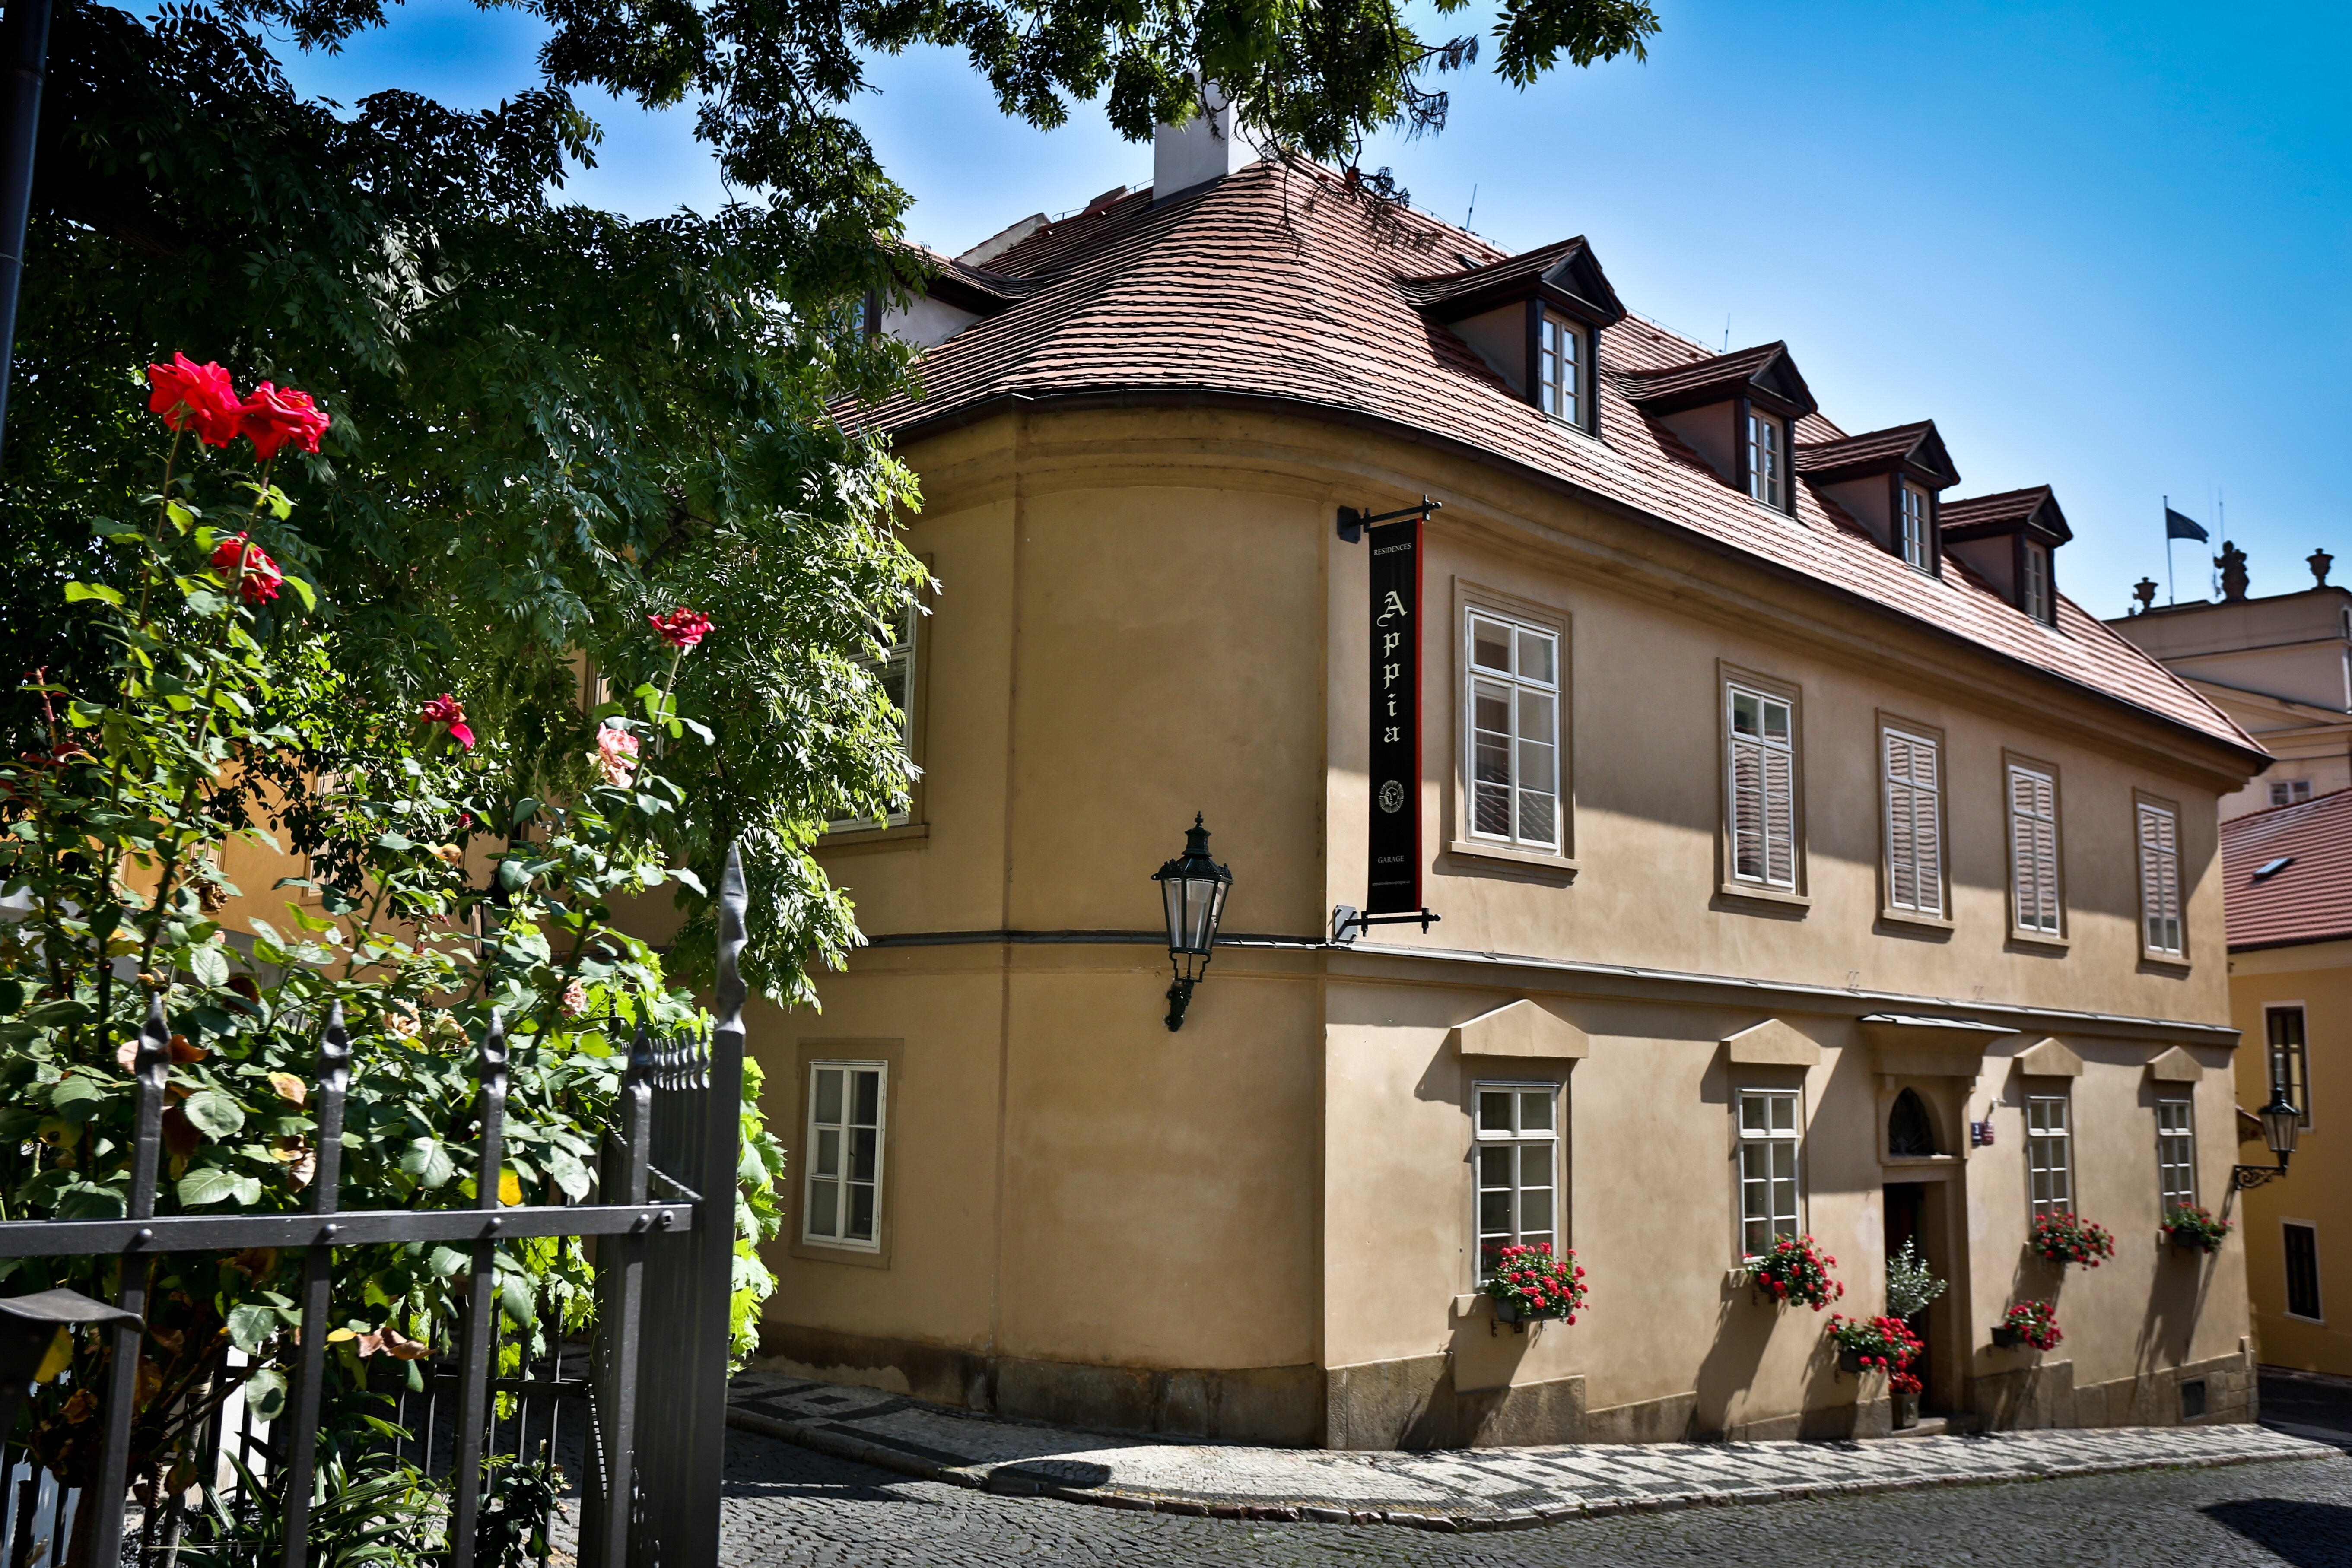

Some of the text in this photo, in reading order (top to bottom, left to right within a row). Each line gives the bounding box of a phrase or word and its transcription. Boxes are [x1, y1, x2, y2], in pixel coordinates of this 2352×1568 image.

[1373, 543, 1411, 556] RESIDENCES
[1376, 590, 1408, 743] Appia
[1377, 855, 1405, 863] GARAGE
